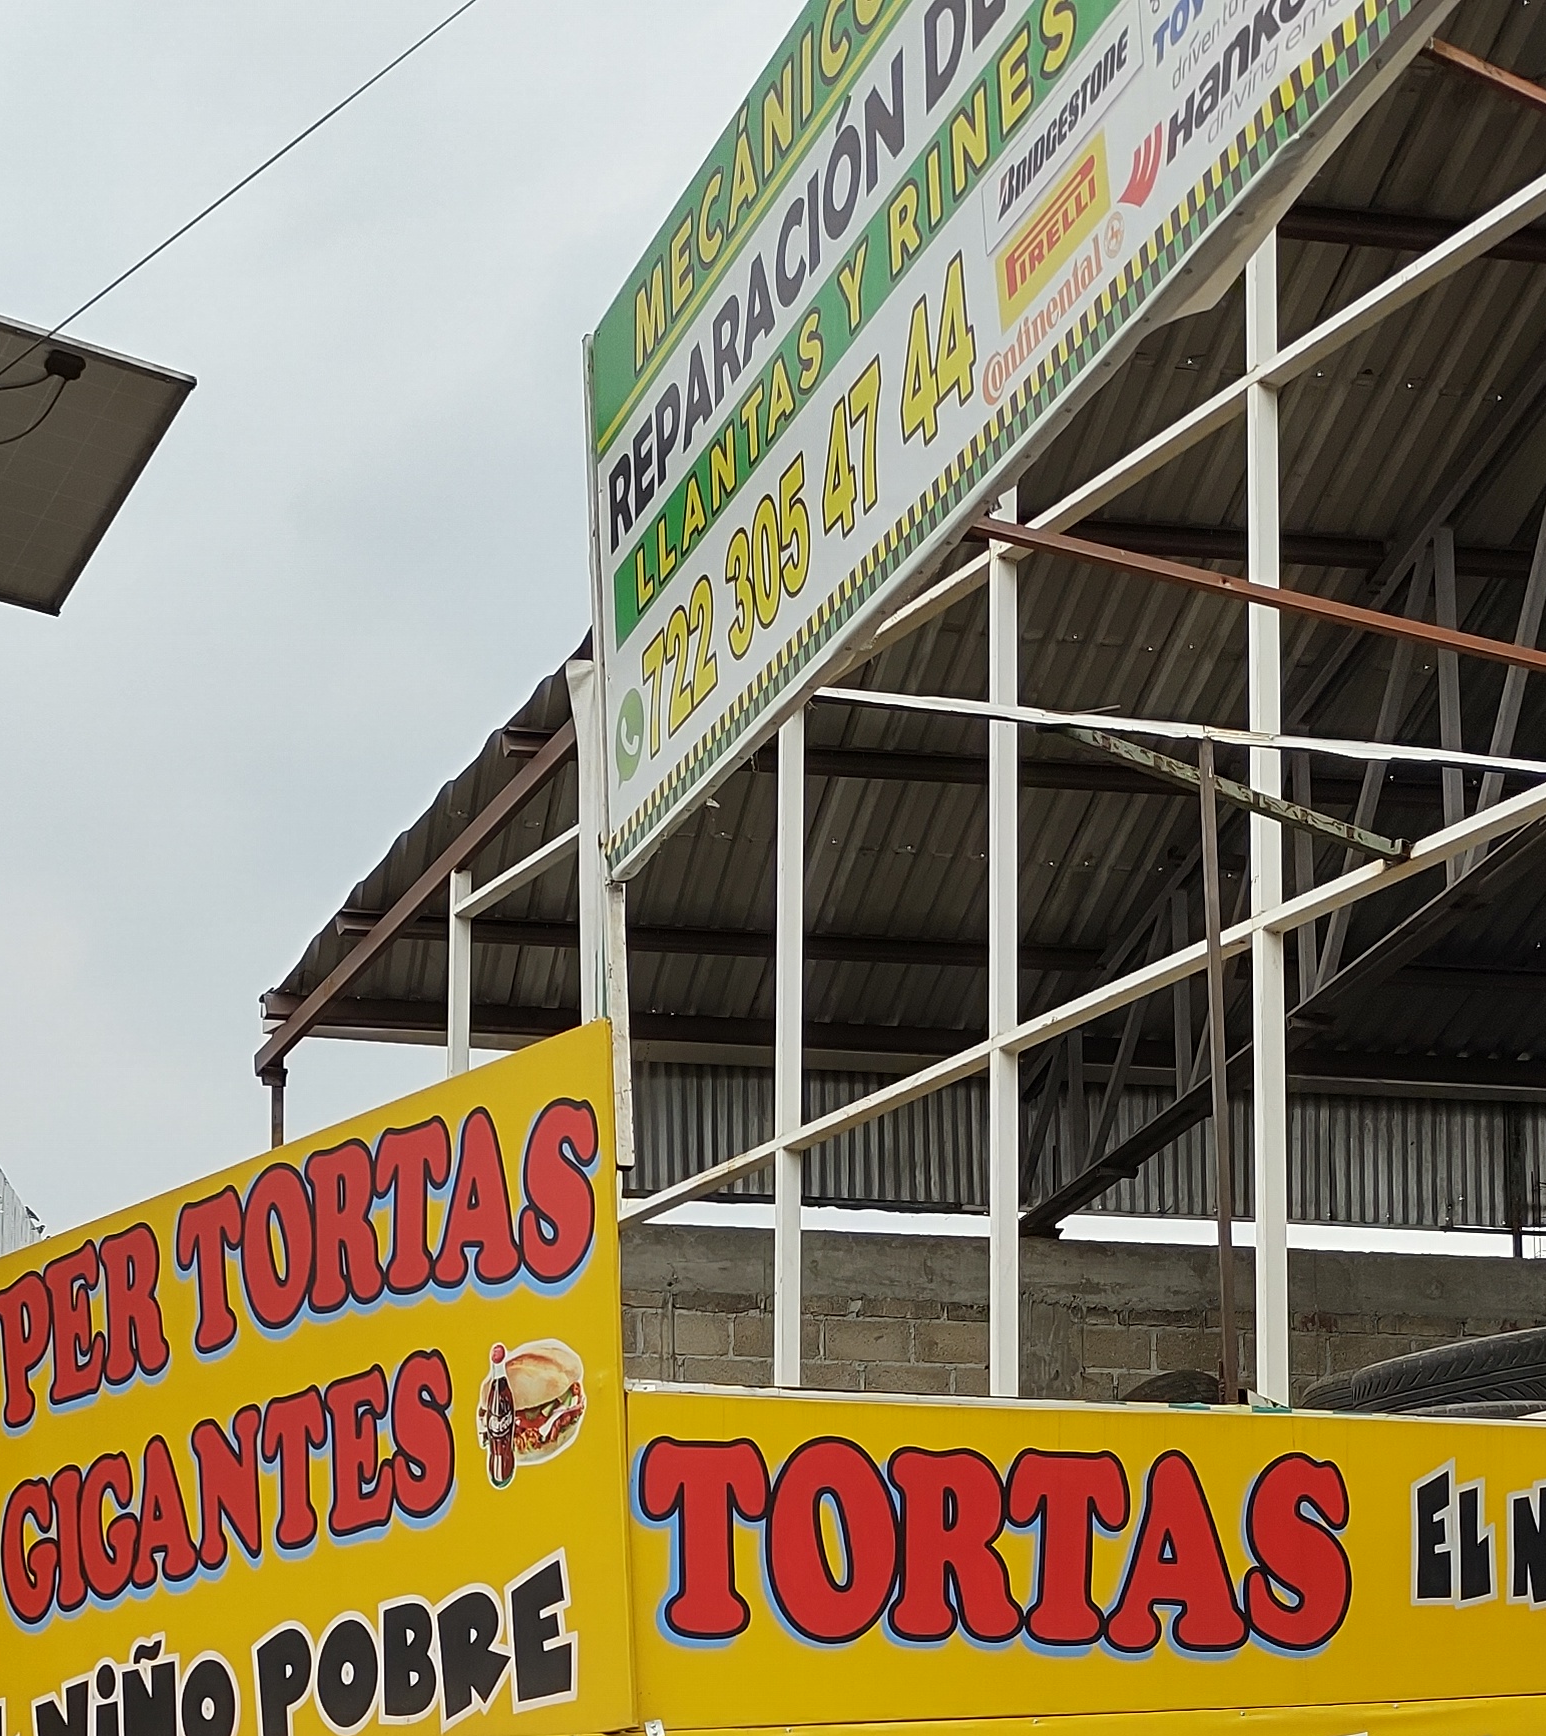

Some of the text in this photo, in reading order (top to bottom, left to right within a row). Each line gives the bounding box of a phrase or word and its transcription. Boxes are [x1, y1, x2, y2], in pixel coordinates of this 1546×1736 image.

[998, 26, 1129, 222] BRIDGESTONE
[1207, 43, 1279, 143] driving
[608, 45, 905, 555] REPARACIÓN
[635, 0, 1077, 614] LLANTAS Y RINES
[982, 238, 1104, 405] Continental
[1005, 154, 1096, 300] PIRELLI
[642, 249, 976, 759] 722 305 47 44
[177, 1097, 600, 1355] TORTAS
[0, 1348, 456, 1627] GIGANTES
[637, 1435, 1352, 1655] TORTAS
[1413, 1459, 1495, 1606] EL
